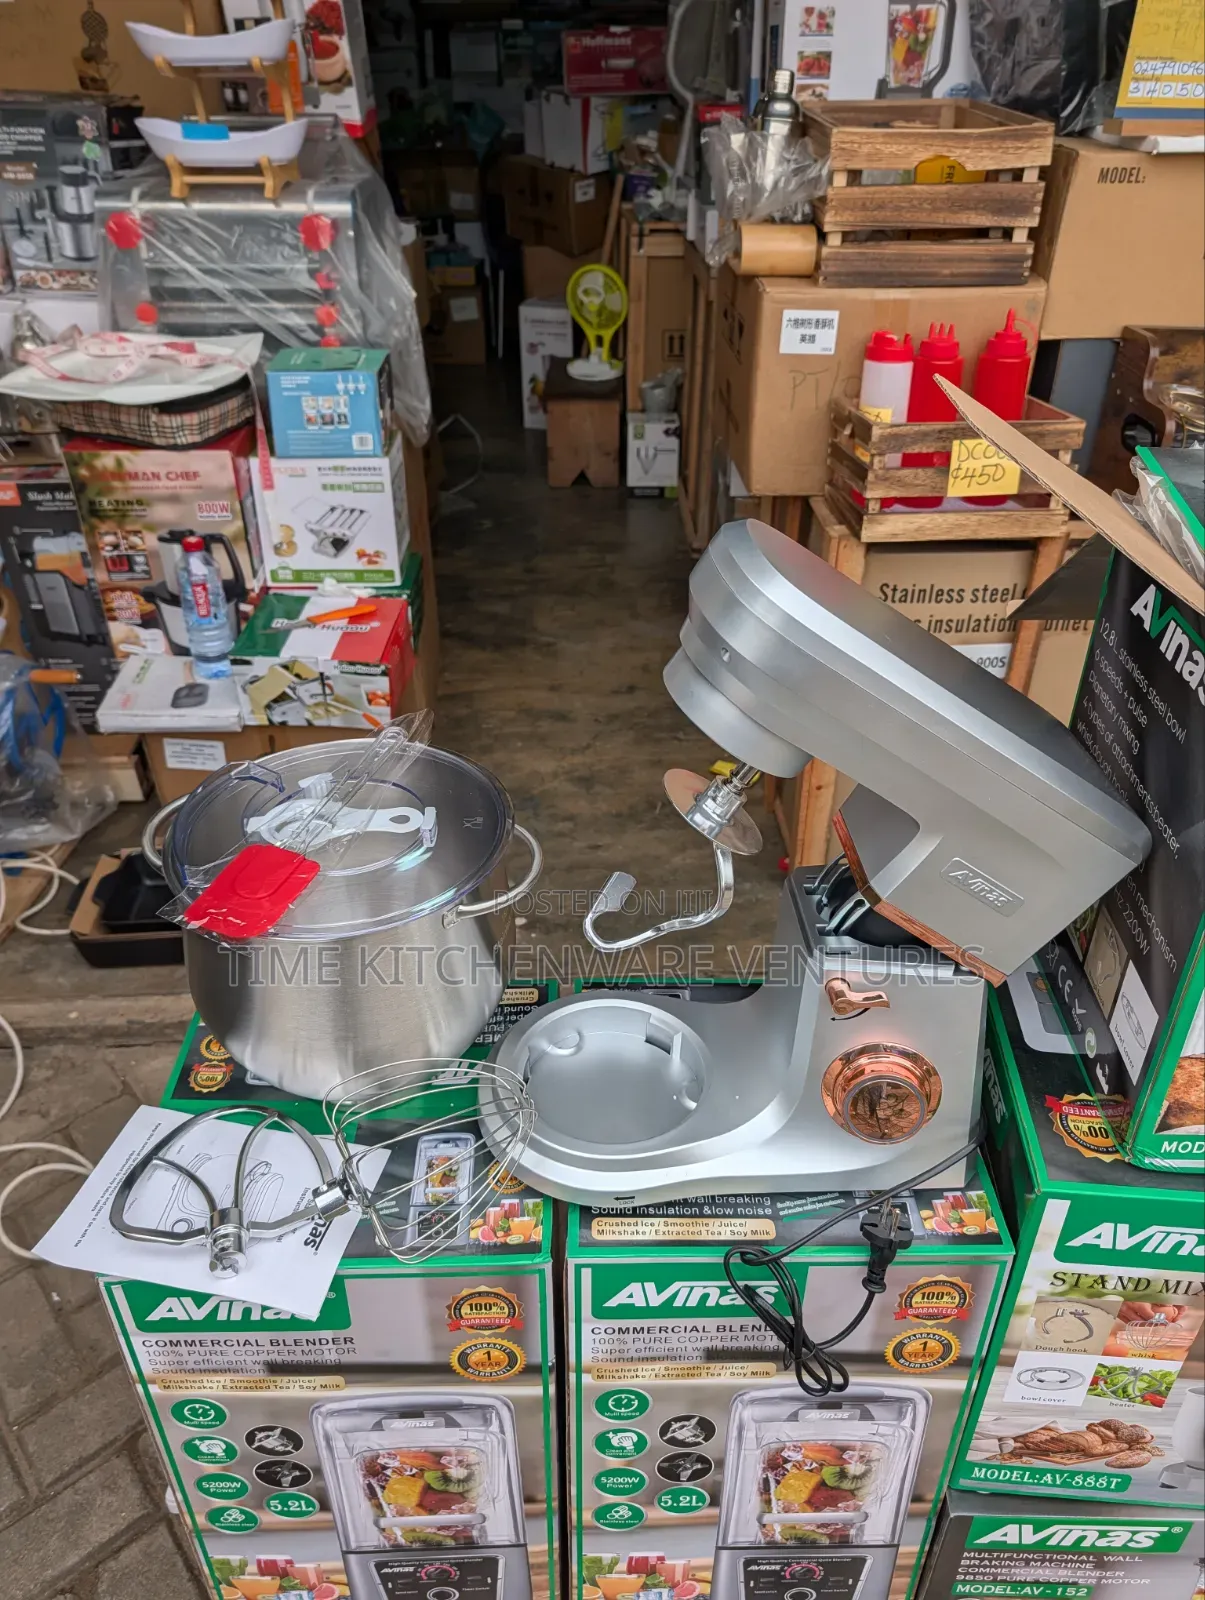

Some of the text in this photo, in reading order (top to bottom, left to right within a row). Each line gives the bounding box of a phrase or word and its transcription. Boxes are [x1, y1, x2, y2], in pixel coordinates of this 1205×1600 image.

[1097, 167, 1146, 184] MODEL:
[165, 471, 201, 481] CHEF
[879, 583, 1018, 604] Stainless steel
[1100, 655, 1125, 695] speeds
[1127, 696, 1148, 728] pulse
[1118, 648, 1149, 693] stainless
[1148, 686, 1168, 719] steel
[1166, 707, 1187, 745] bowl
[1088, 669, 1140, 756] Planetary mixing
[1122, 908, 1151, 957] 2200W
[1135, 891, 1178, 974] mechanism
[714, 1194, 771, 1205] breaking
[636, 1205, 700, 1216] insulation
[702, 1206, 734, 1216] &low
[737, 1206, 773, 1216] noise
[596, 1219, 639, 1228] Crushed
[641, 1219, 656, 1228] Ice
[663, 1220, 710, 1229] Smoothie
[596, 1228, 771, 1238] Milkshake Extracted Tea Soy Milk
[1064, 1222, 1205, 1256] AVin
[1049, 1270, 1151, 1293] STAND
[919, 1291, 957, 1301] 100%
[466, 1302, 506, 1313] 100%
[907, 1307, 958, 1315] GUARANTEED
[460, 1317, 511, 1326] GUARANTEED
[591, 1325, 712, 1335] COMMERCIAL
[141, 1336, 356, 1348] COMMERCIAL BLENDER
[591, 1335, 740, 1346] 100% PURE COPPER
[902, 1333, 950, 1344] WARRANTY
[145, 1347, 358, 1357] 100% PURE COPPER MOTOR
[464, 1343, 512, 1354] WARRANTY
[590, 1343, 781, 1356] Super efficient wall breaking
[1035, 1343, 1089, 1354] Dough hook
[590, 1355, 633, 1364] Sound
[636, 1353, 703, 1363] insulation
[1131, 1351, 1157, 1360] whisk
[148, 1357, 342, 1368] Super efficient wall breaking
[898, 1358, 943, 1369] WARRANTY
[151, 1366, 266, 1375] Sound insulation
[466, 1366, 513, 1377] WARRANTY
[596, 1366, 640, 1374] Crushed
[729, 1371, 748, 1379] Soy
[600, 1476, 641, 1484] 5200W
[971, 1466, 1123, 1491] MODEL:AV-888T
[269, 1500, 315, 1511] 5.2L
[660, 1495, 704, 1507] 5.2L
[962, 1551, 1099, 1562] MULTIFUNCTIONAL
[1035, 1561, 1096, 1569] MACHINE
[957, 1567, 1126, 1577] COMMERCIAL BLENDER
[1040, 1576, 1099, 1584] COPPER
[1100, 1577, 1152, 1585] MOTOR
